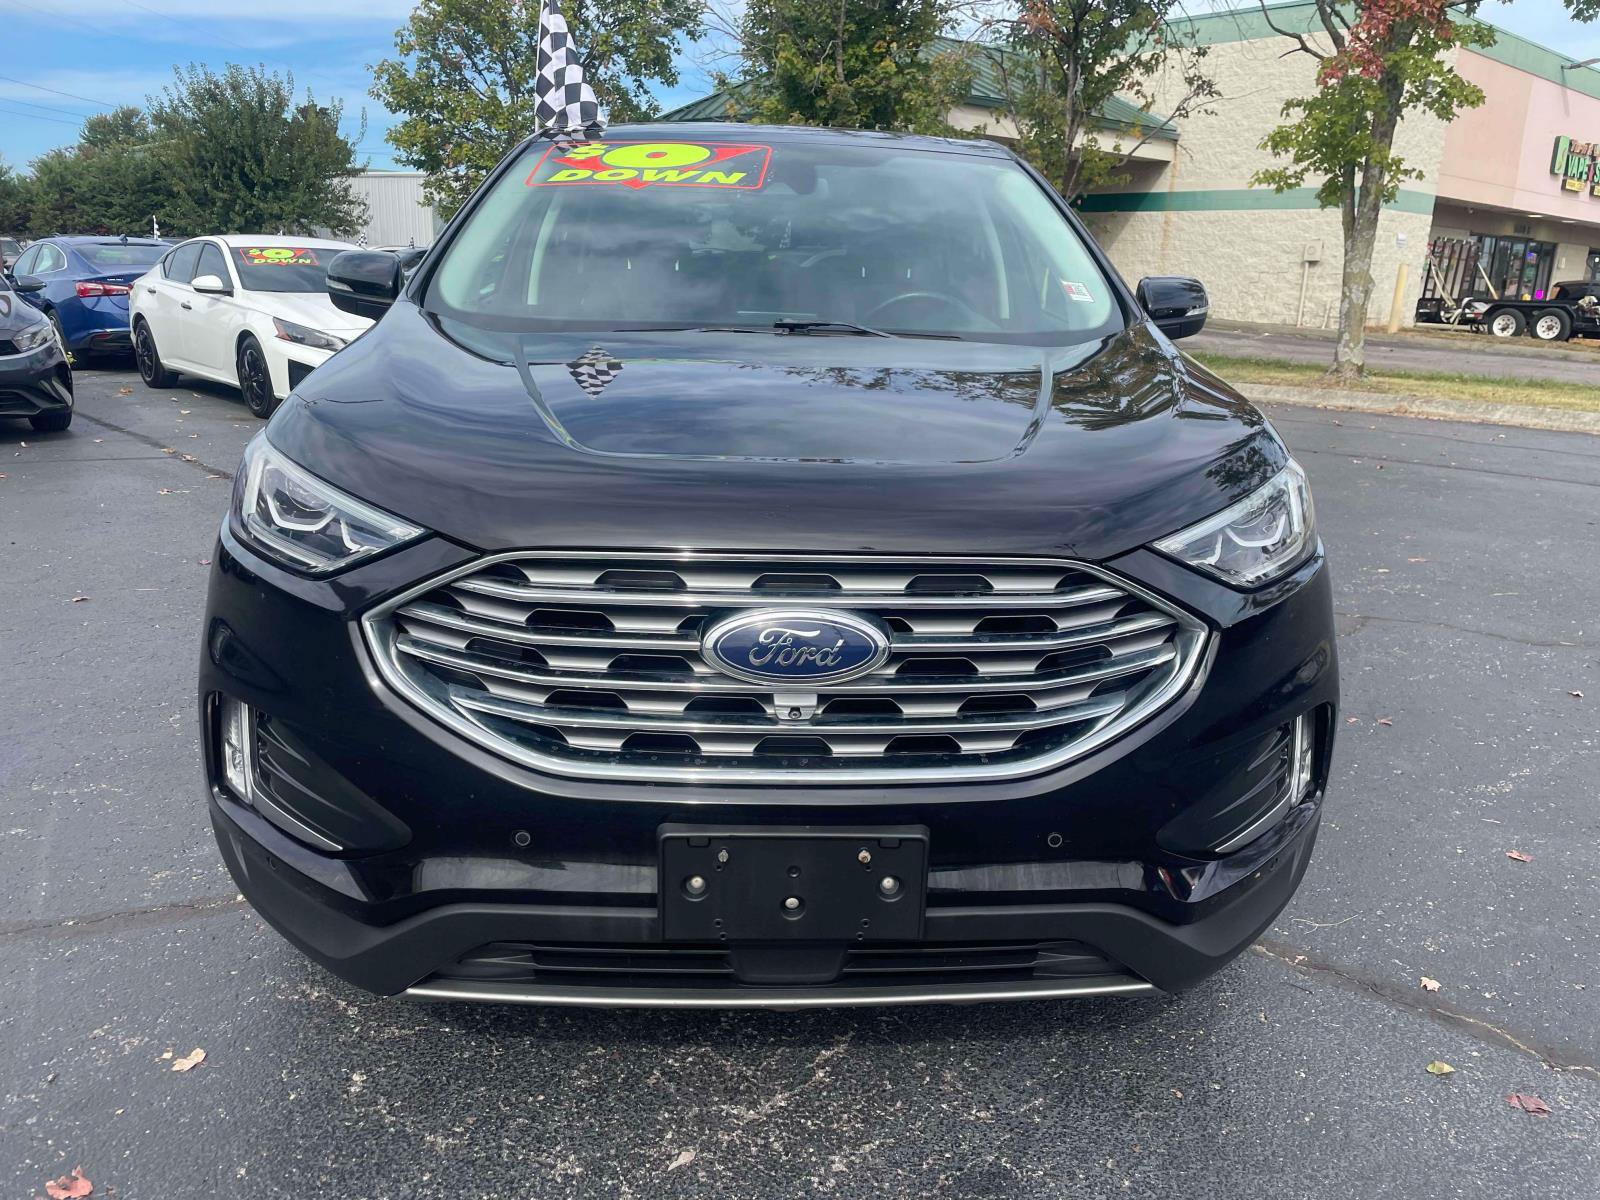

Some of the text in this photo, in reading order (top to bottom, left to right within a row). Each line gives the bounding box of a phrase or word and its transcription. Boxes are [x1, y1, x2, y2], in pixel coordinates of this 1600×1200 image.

[547, 169, 747, 184] DOWN
[1568, 154, 1589, 181] VAPE
[749, 627, 844, 667] Ford
